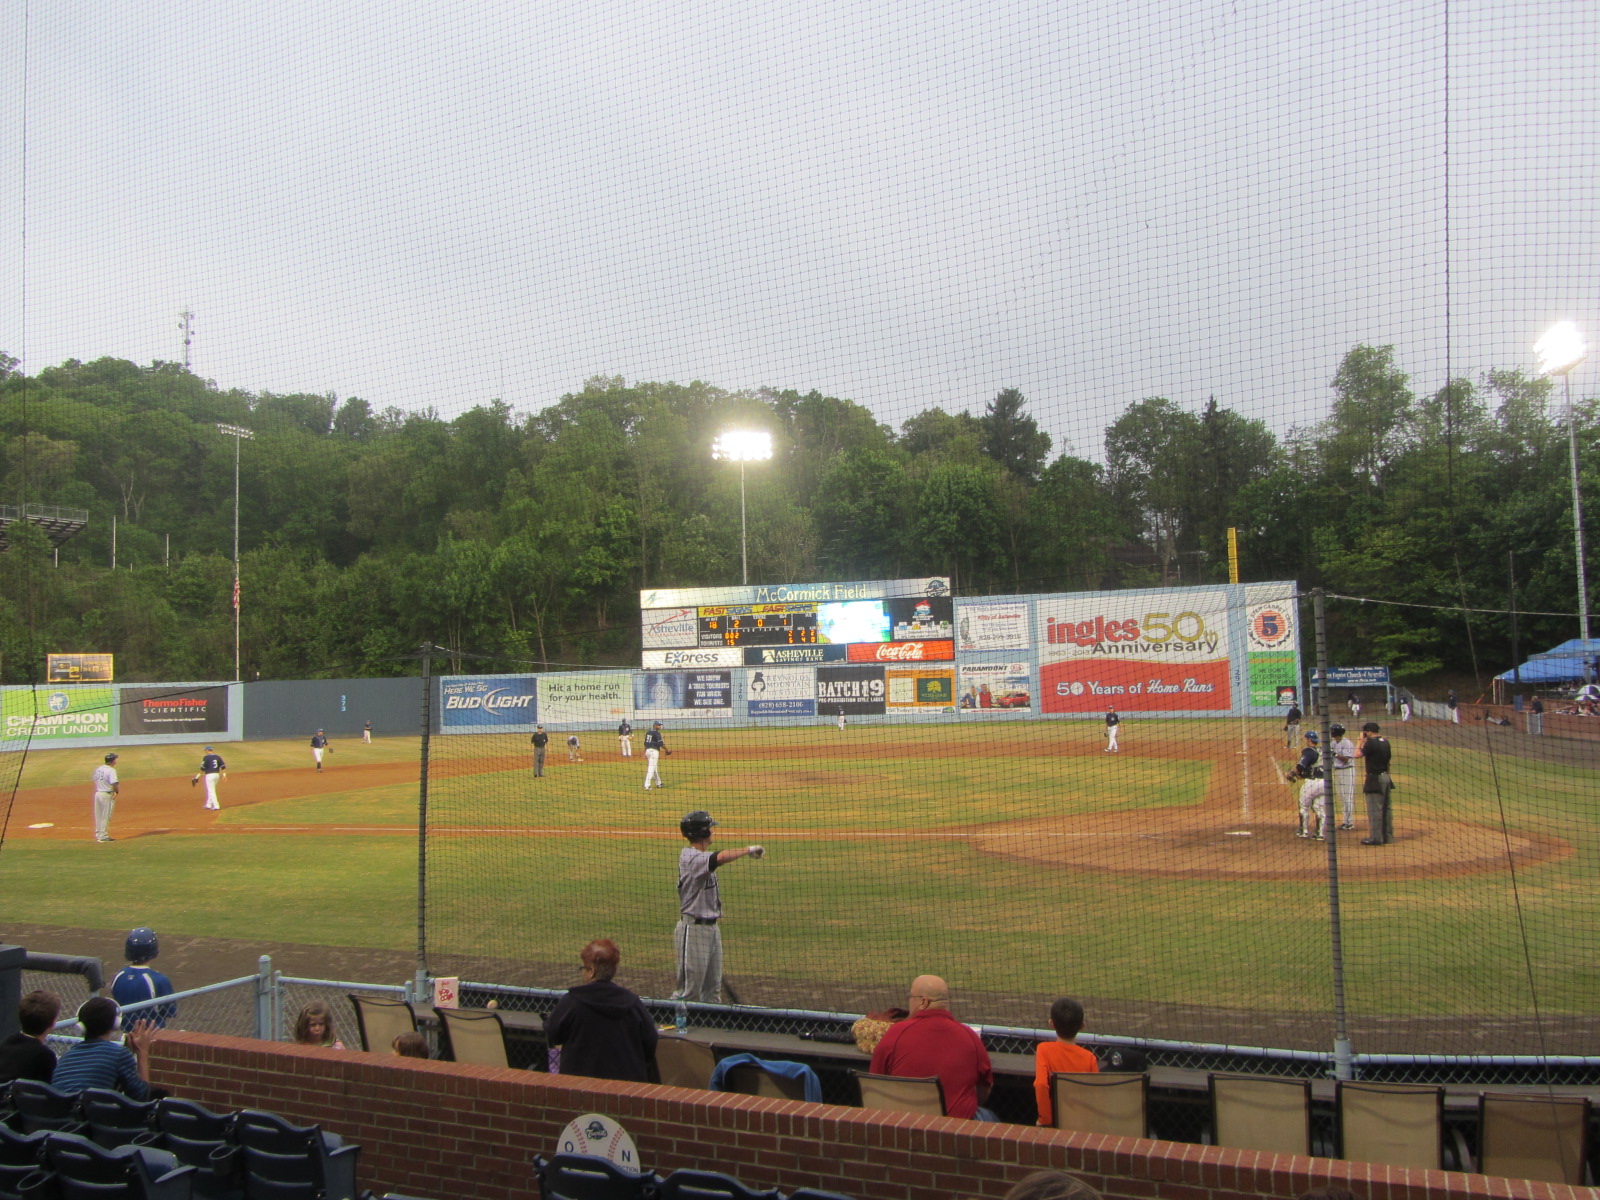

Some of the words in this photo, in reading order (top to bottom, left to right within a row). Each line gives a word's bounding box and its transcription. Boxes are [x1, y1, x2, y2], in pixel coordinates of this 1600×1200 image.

[756, 586, 830, 603] McCormick
[834, 584, 866, 599] Field
[647, 622, 694, 635] Asheville
[734, 620, 740, 628] 2
[757, 619, 763, 627] 0
[1261, 616, 1278, 637] 5
[1047, 615, 1140, 647] ingles
[775, 648, 825, 659] ASHEVILLE
[875, 643, 924, 660] Coca-Cola
[1092, 639, 1218, 655] Anniversary
[664, 652, 719, 666] Express
[549, 683, 563, 692] Hit
[574, 683, 601, 691] home
[818, 680, 861, 698] BATCH
[861, 679, 885, 697] 19
[1087, 680, 1124, 695] Years
[1129, 682, 1142, 694] of
[1147, 679, 1181, 694] Home
[1183, 678, 1214, 693] Runs
[446, 695, 481, 709] BUD
[487, 695, 533, 708] LIGHT
[549, 693, 562, 702] for
[565, 695, 586, 703] your
[589, 691, 621, 701] health.
[143, 706, 207, 714] SCIENTIFIC
[758, 702, 775, 710] (828)
[6, 713, 108, 728] CHAMPION
[6, 725, 59, 737] CREDIT
[63, 724, 108, 735] UNION
[212, 759, 218, 769] 3
[564, 1141, 574, 1153] O
[621, 1149, 631, 1163] N
[619, 1165, 639, 1173] CTION
